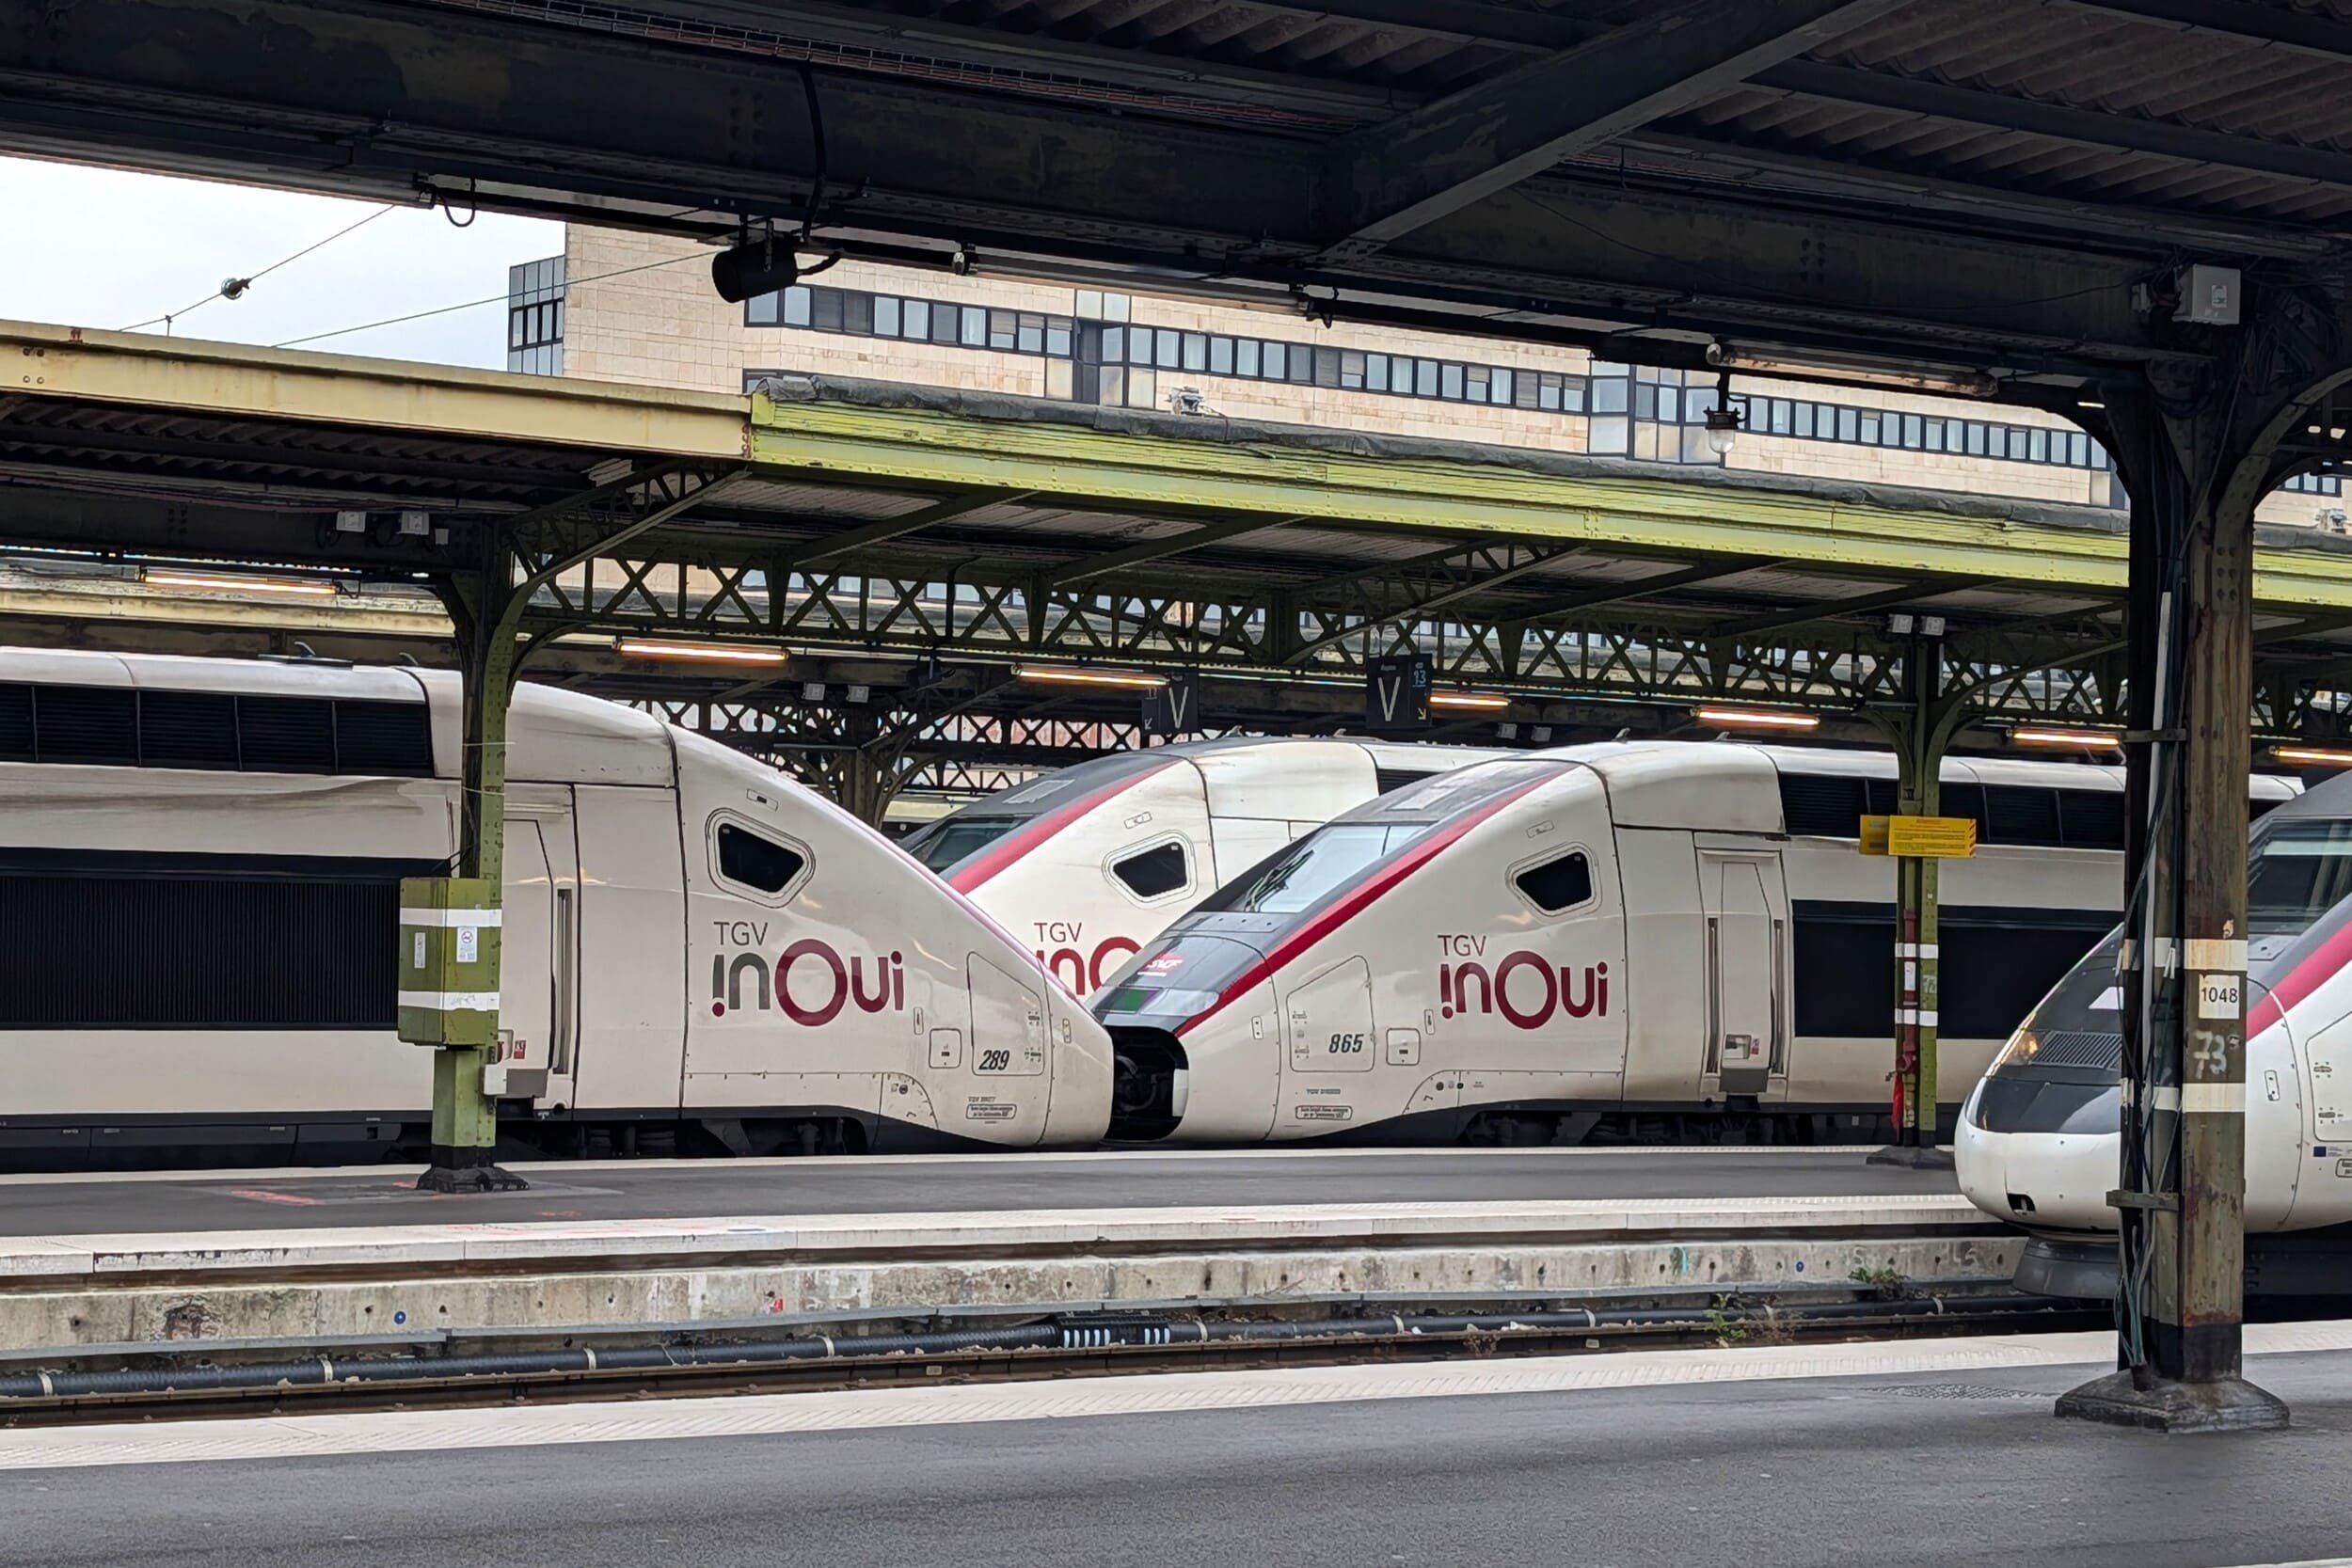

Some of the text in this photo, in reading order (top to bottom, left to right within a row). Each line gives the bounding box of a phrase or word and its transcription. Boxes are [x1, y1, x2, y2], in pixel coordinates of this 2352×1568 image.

[1413, 670, 1426, 685] 13
[1168, 686, 1189, 729] V
[1377, 675, 1401, 721] V
[713, 921, 768, 946] TGV
[1033, 920, 1082, 942] TGV
[1437, 934, 1487, 957] TGV
[2201, 987, 2238, 1004] 1048
[1328, 1033, 1364, 1053] 865
[978, 1049, 1010, 1070] 289
[2193, 1030, 2227, 1080] 73
